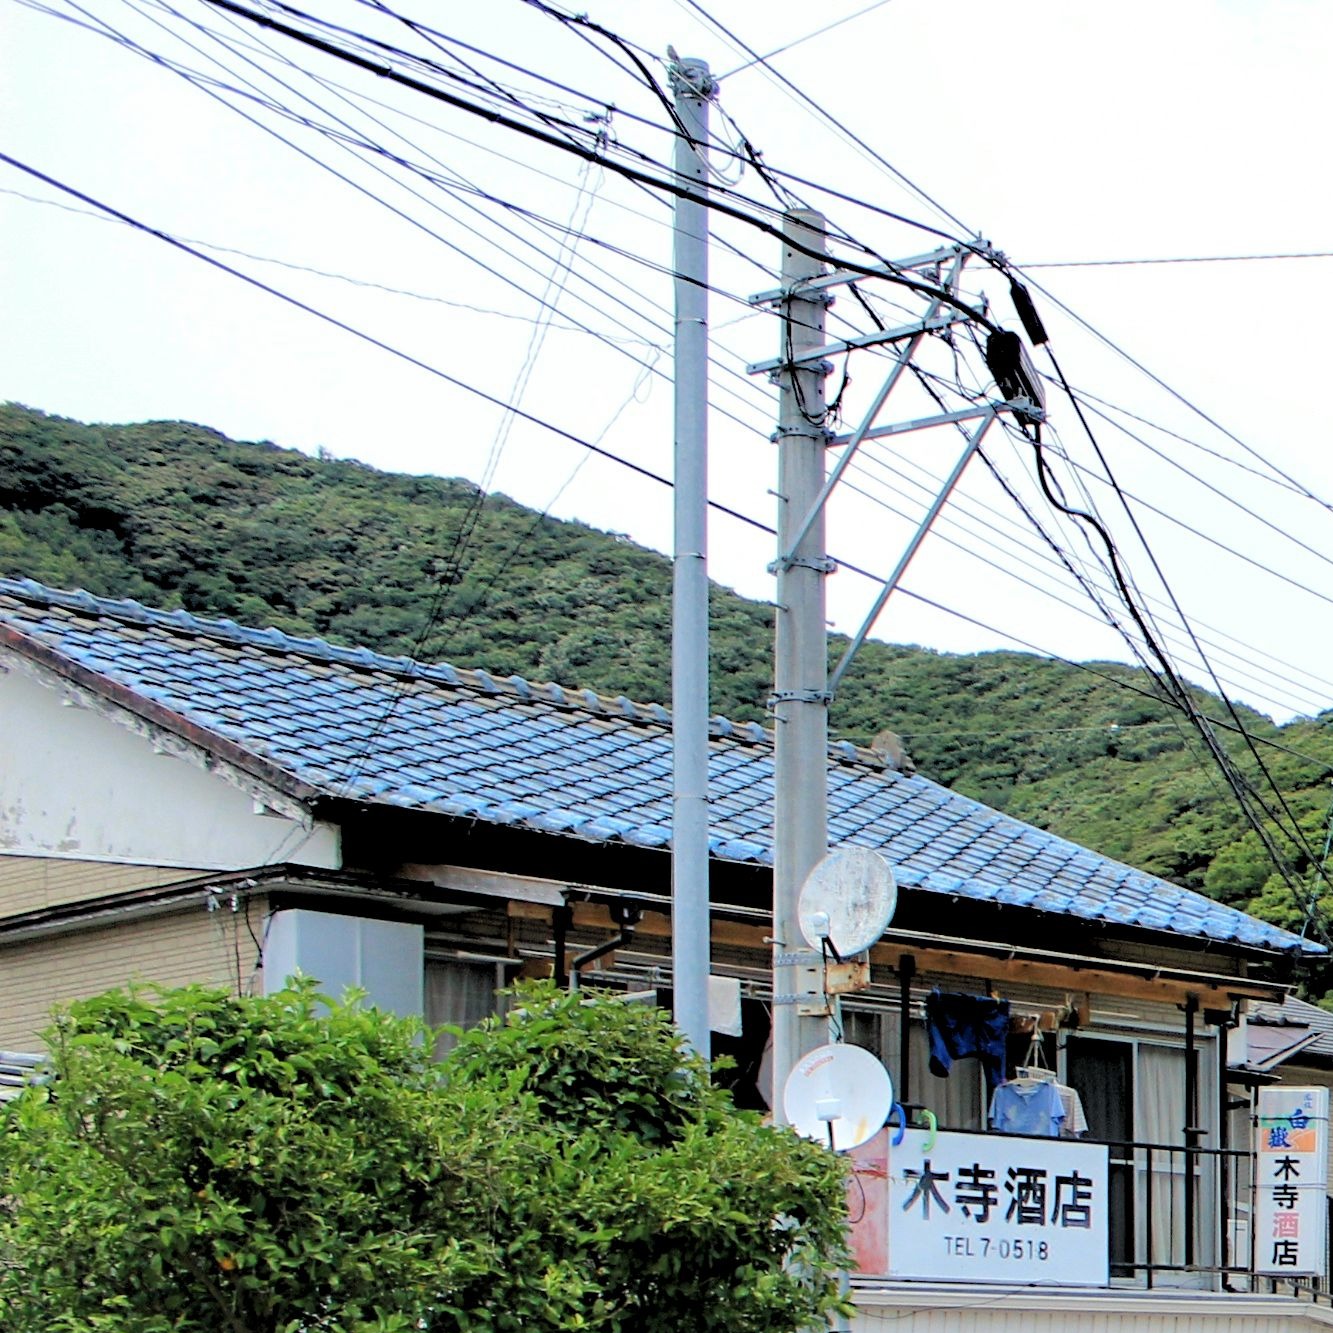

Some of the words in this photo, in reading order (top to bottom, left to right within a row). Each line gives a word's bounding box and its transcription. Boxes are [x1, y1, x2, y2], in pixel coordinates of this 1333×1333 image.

[903, 1158, 1093, 1229] 木寺酒店
[1272, 1155, 1300, 1266] 木寺酒店
[944, 1236, 974, 1257] TEL
[980, 1237, 1049, 1261] 7-0518
